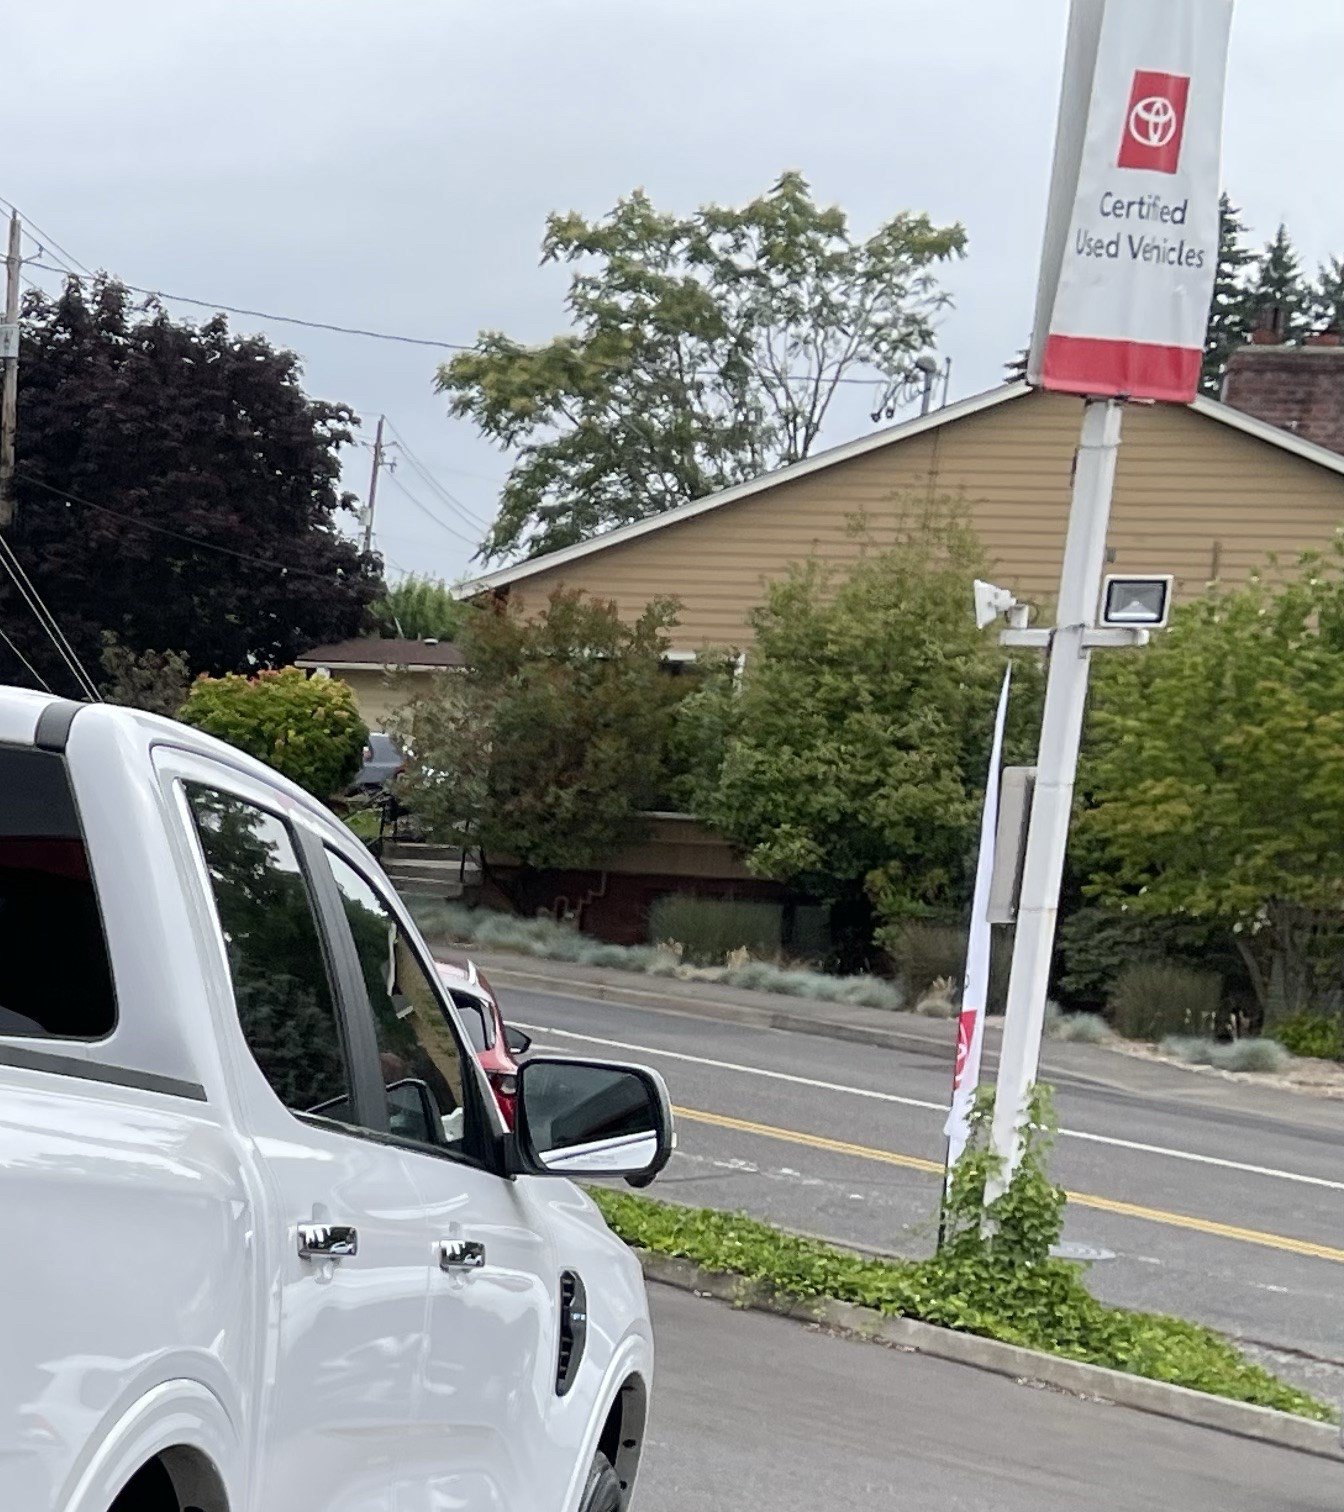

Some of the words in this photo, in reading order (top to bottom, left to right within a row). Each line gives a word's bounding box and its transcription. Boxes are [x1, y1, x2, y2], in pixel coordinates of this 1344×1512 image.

[1099, 191, 1189, 225] Certified
[1075, 228, 1121, 258] Used
[1128, 234, 1205, 268] Vehicles
